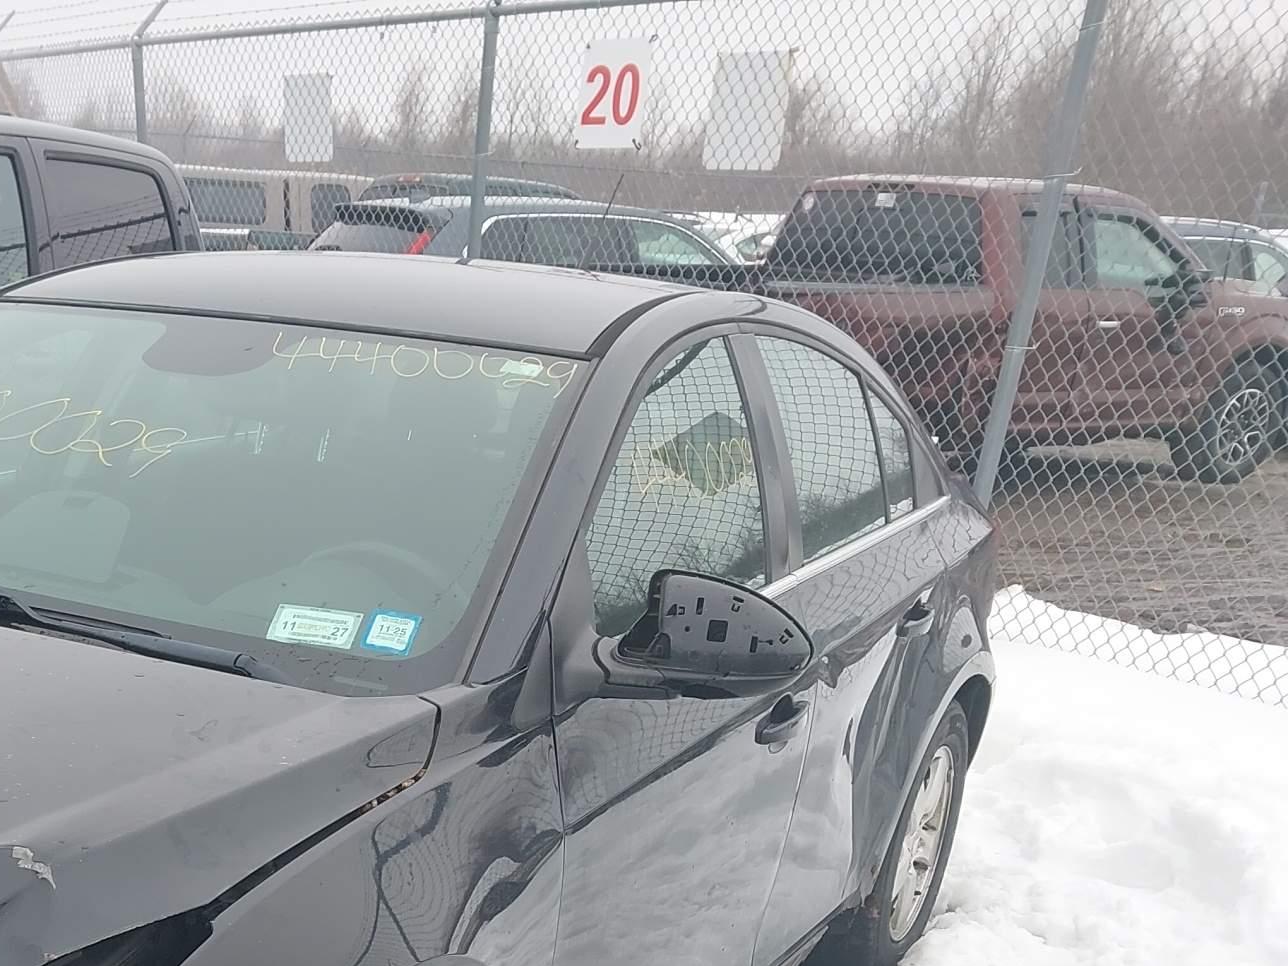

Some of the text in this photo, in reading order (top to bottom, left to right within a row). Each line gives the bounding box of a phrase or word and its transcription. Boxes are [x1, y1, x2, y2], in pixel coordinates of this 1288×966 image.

[580, 63, 640, 126] 20
[271, 332, 578, 398] 44400029
[282, 620, 297, 631] 11
[330, 626, 349, 638] 27
